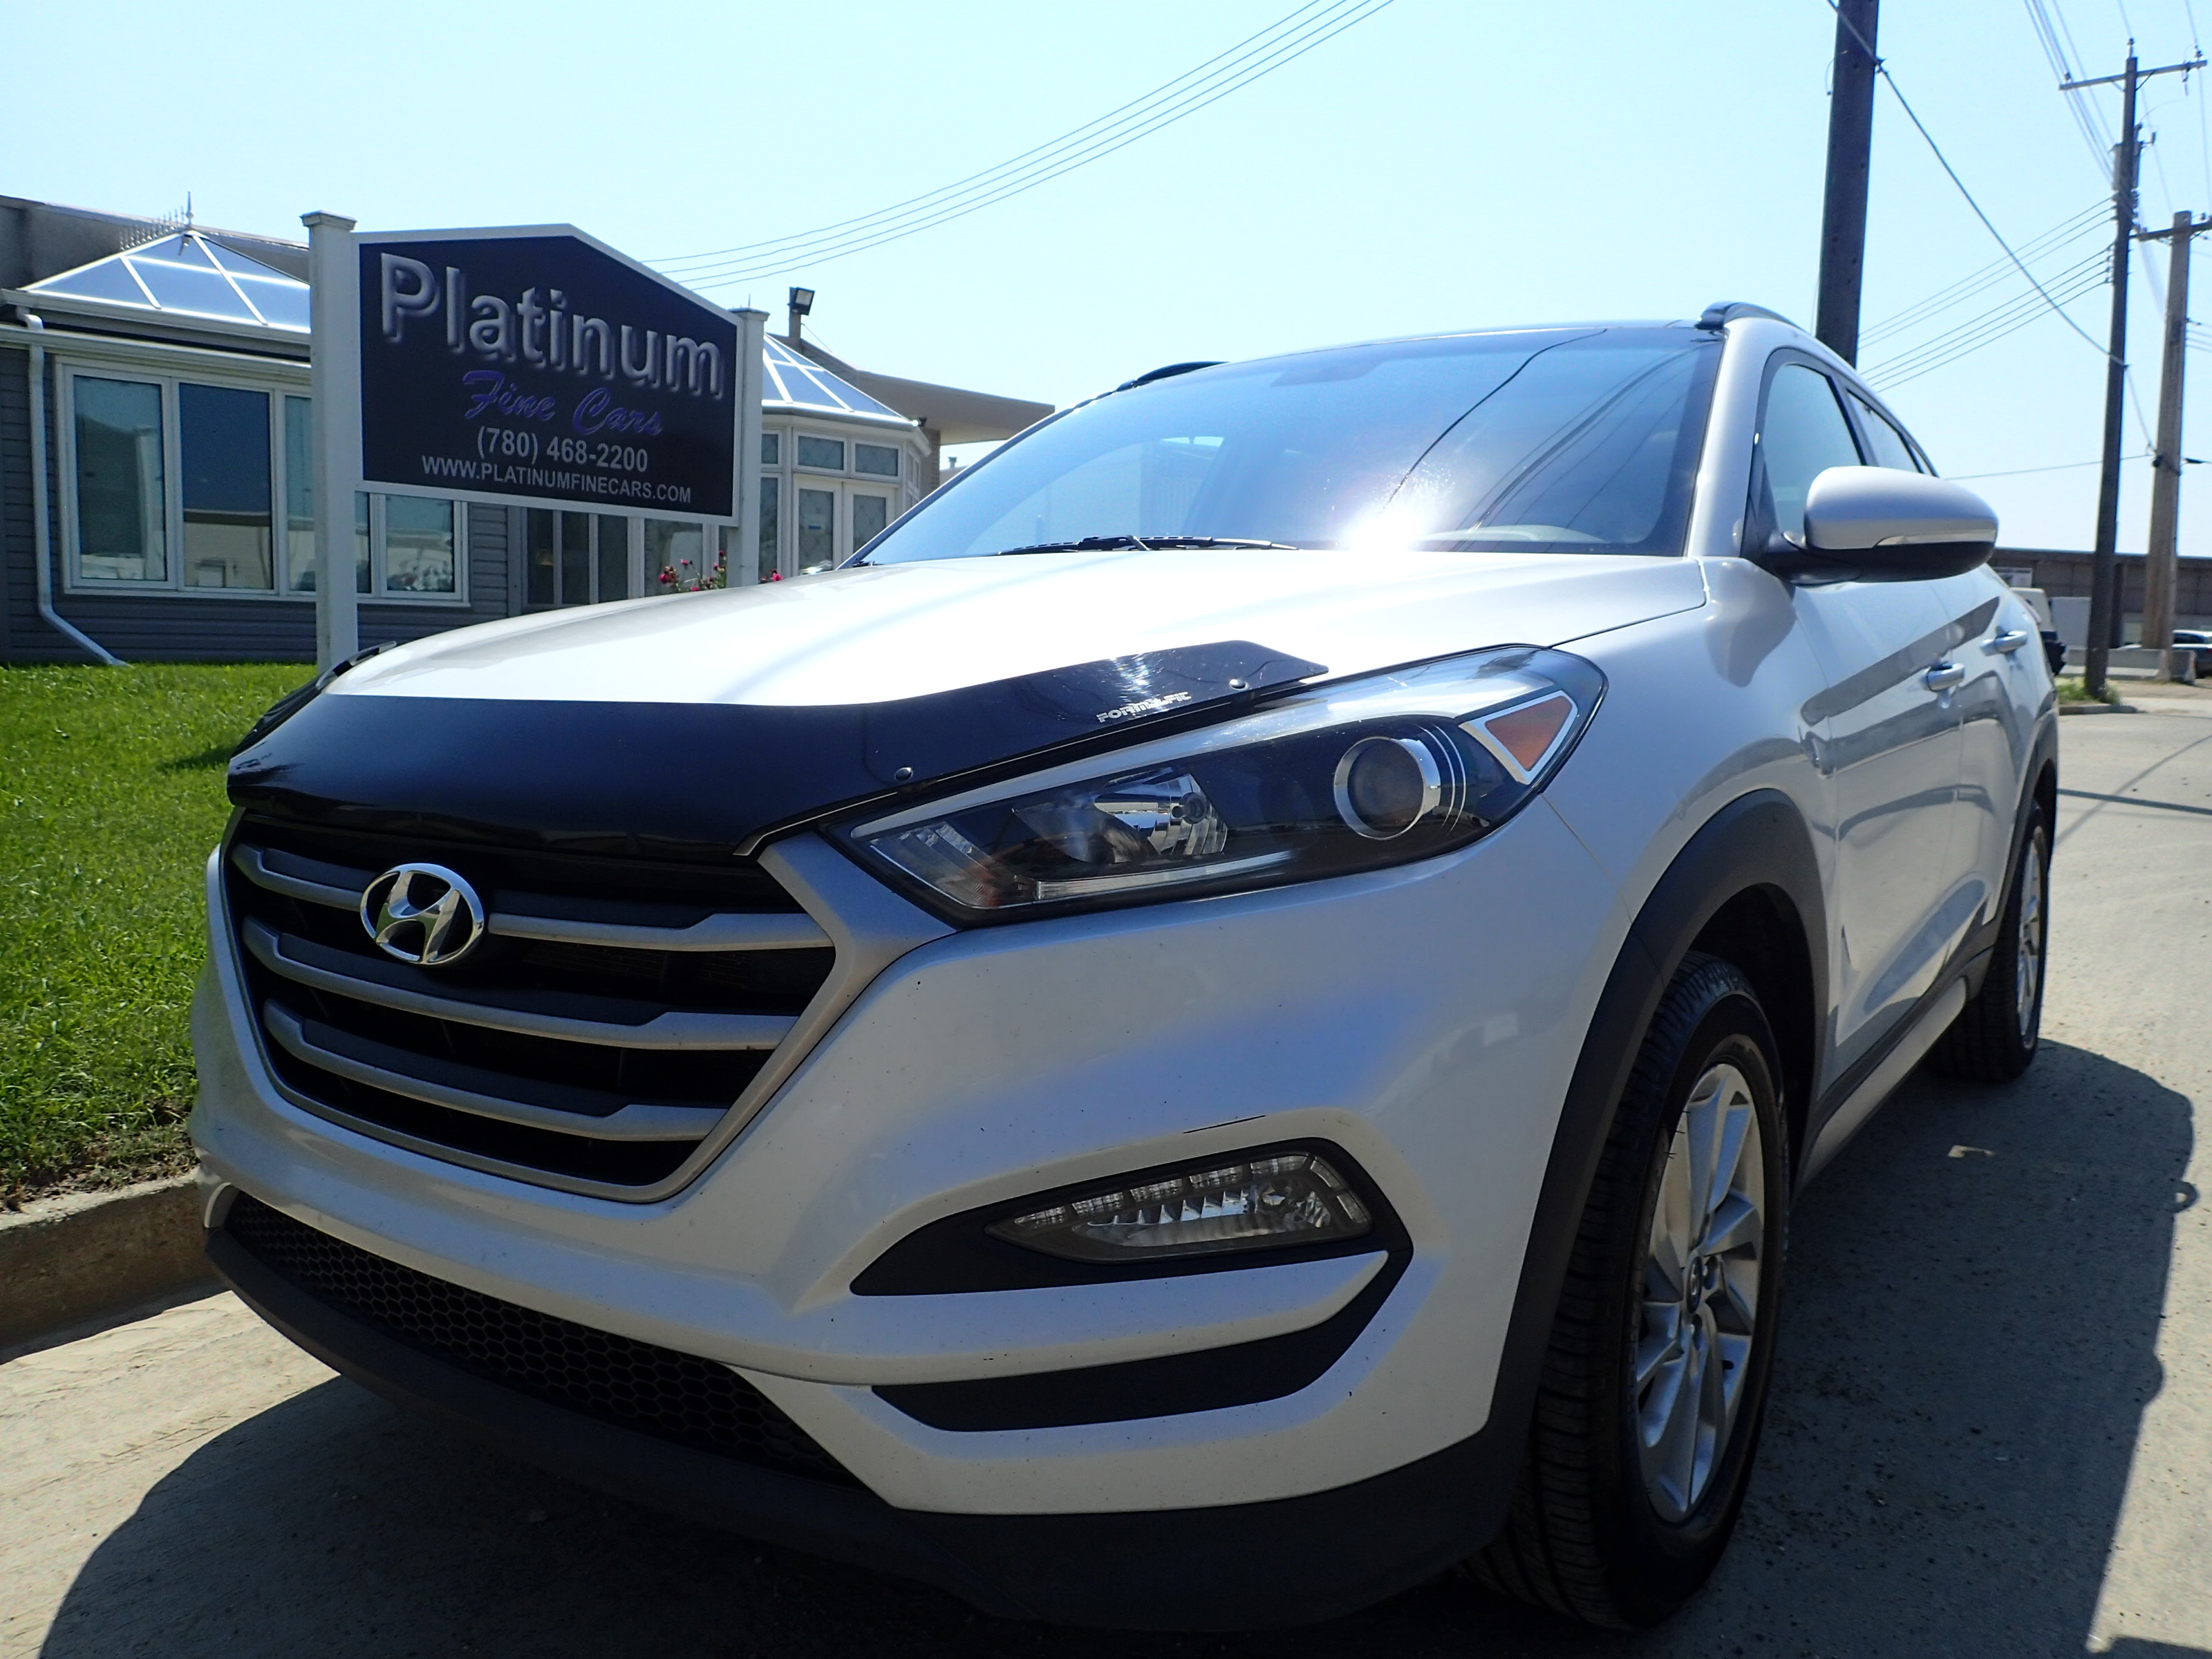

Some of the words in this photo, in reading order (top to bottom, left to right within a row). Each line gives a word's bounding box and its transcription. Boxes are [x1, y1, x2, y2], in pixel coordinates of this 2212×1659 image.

[381, 252, 723, 399] Platinum
[463, 370, 556, 420] Fine
[572, 387, 663, 436] Cars
[477, 426, 538, 465] (780)
[546, 436, 648, 472] 468-2200
[422, 455, 691, 503] WWW.PLATINUMFINECARS.COM
